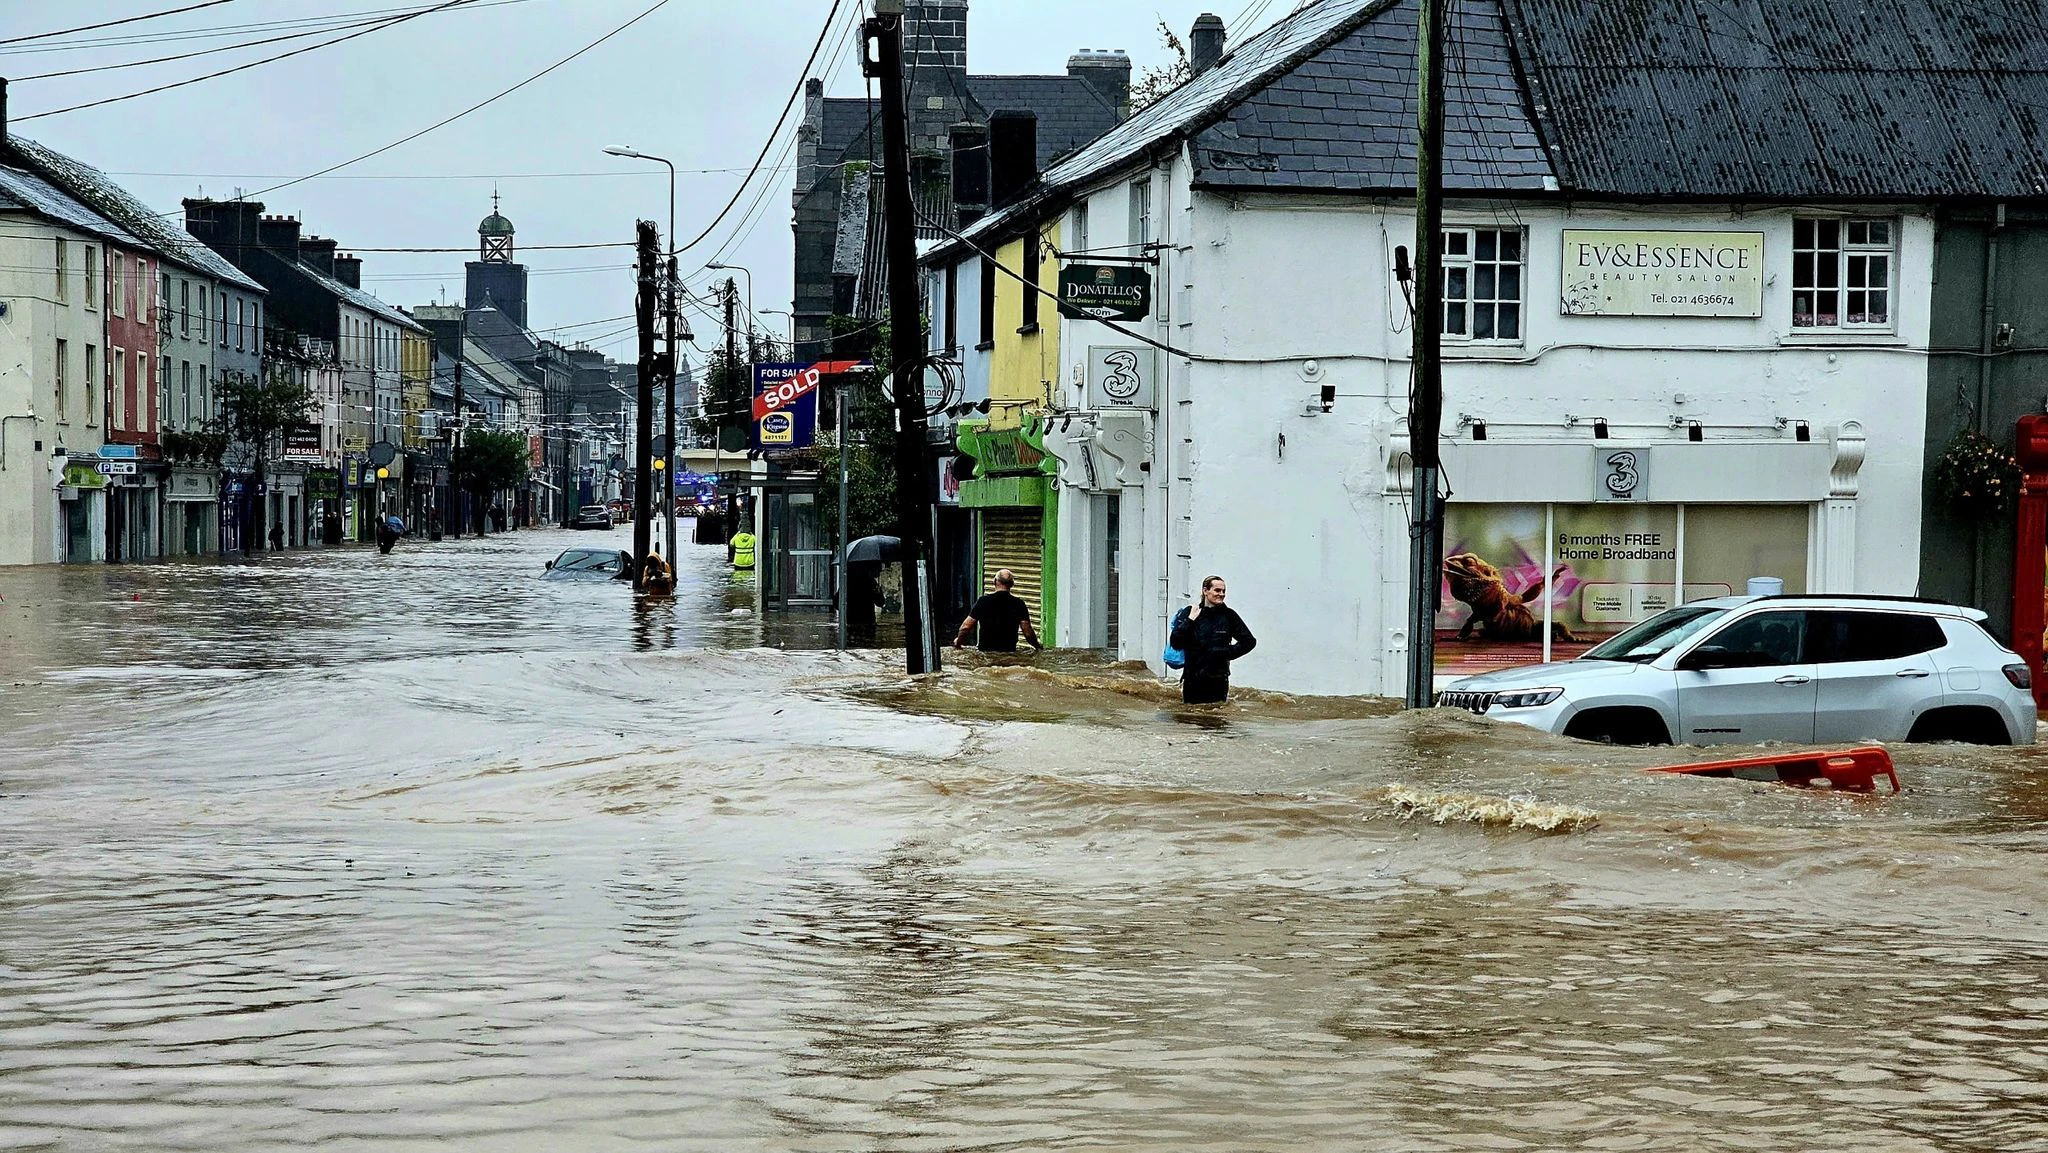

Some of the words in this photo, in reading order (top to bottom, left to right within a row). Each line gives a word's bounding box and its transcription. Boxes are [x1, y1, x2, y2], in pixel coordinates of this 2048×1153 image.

[1590, 273, 1660, 281] BEAUTY
[1677, 274, 1736, 282] SALON
[1651, 294, 1668, 303] Tel.
[1671, 295, 1687, 304] 021
[1691, 294, 1734, 305] 4636674
[761, 369, 779, 378] FOR
[1103, 351, 1140, 398] 3
[764, 368, 819, 409] SOLD
[1606, 451, 1639, 493] 3
[1559, 534, 1567, 545] 6
[1570, 534, 1621, 545] months
[1624, 534, 1661, 545] FREE
[1560, 548, 1599, 560] Home
[1602, 548, 1676, 560] Broadband
